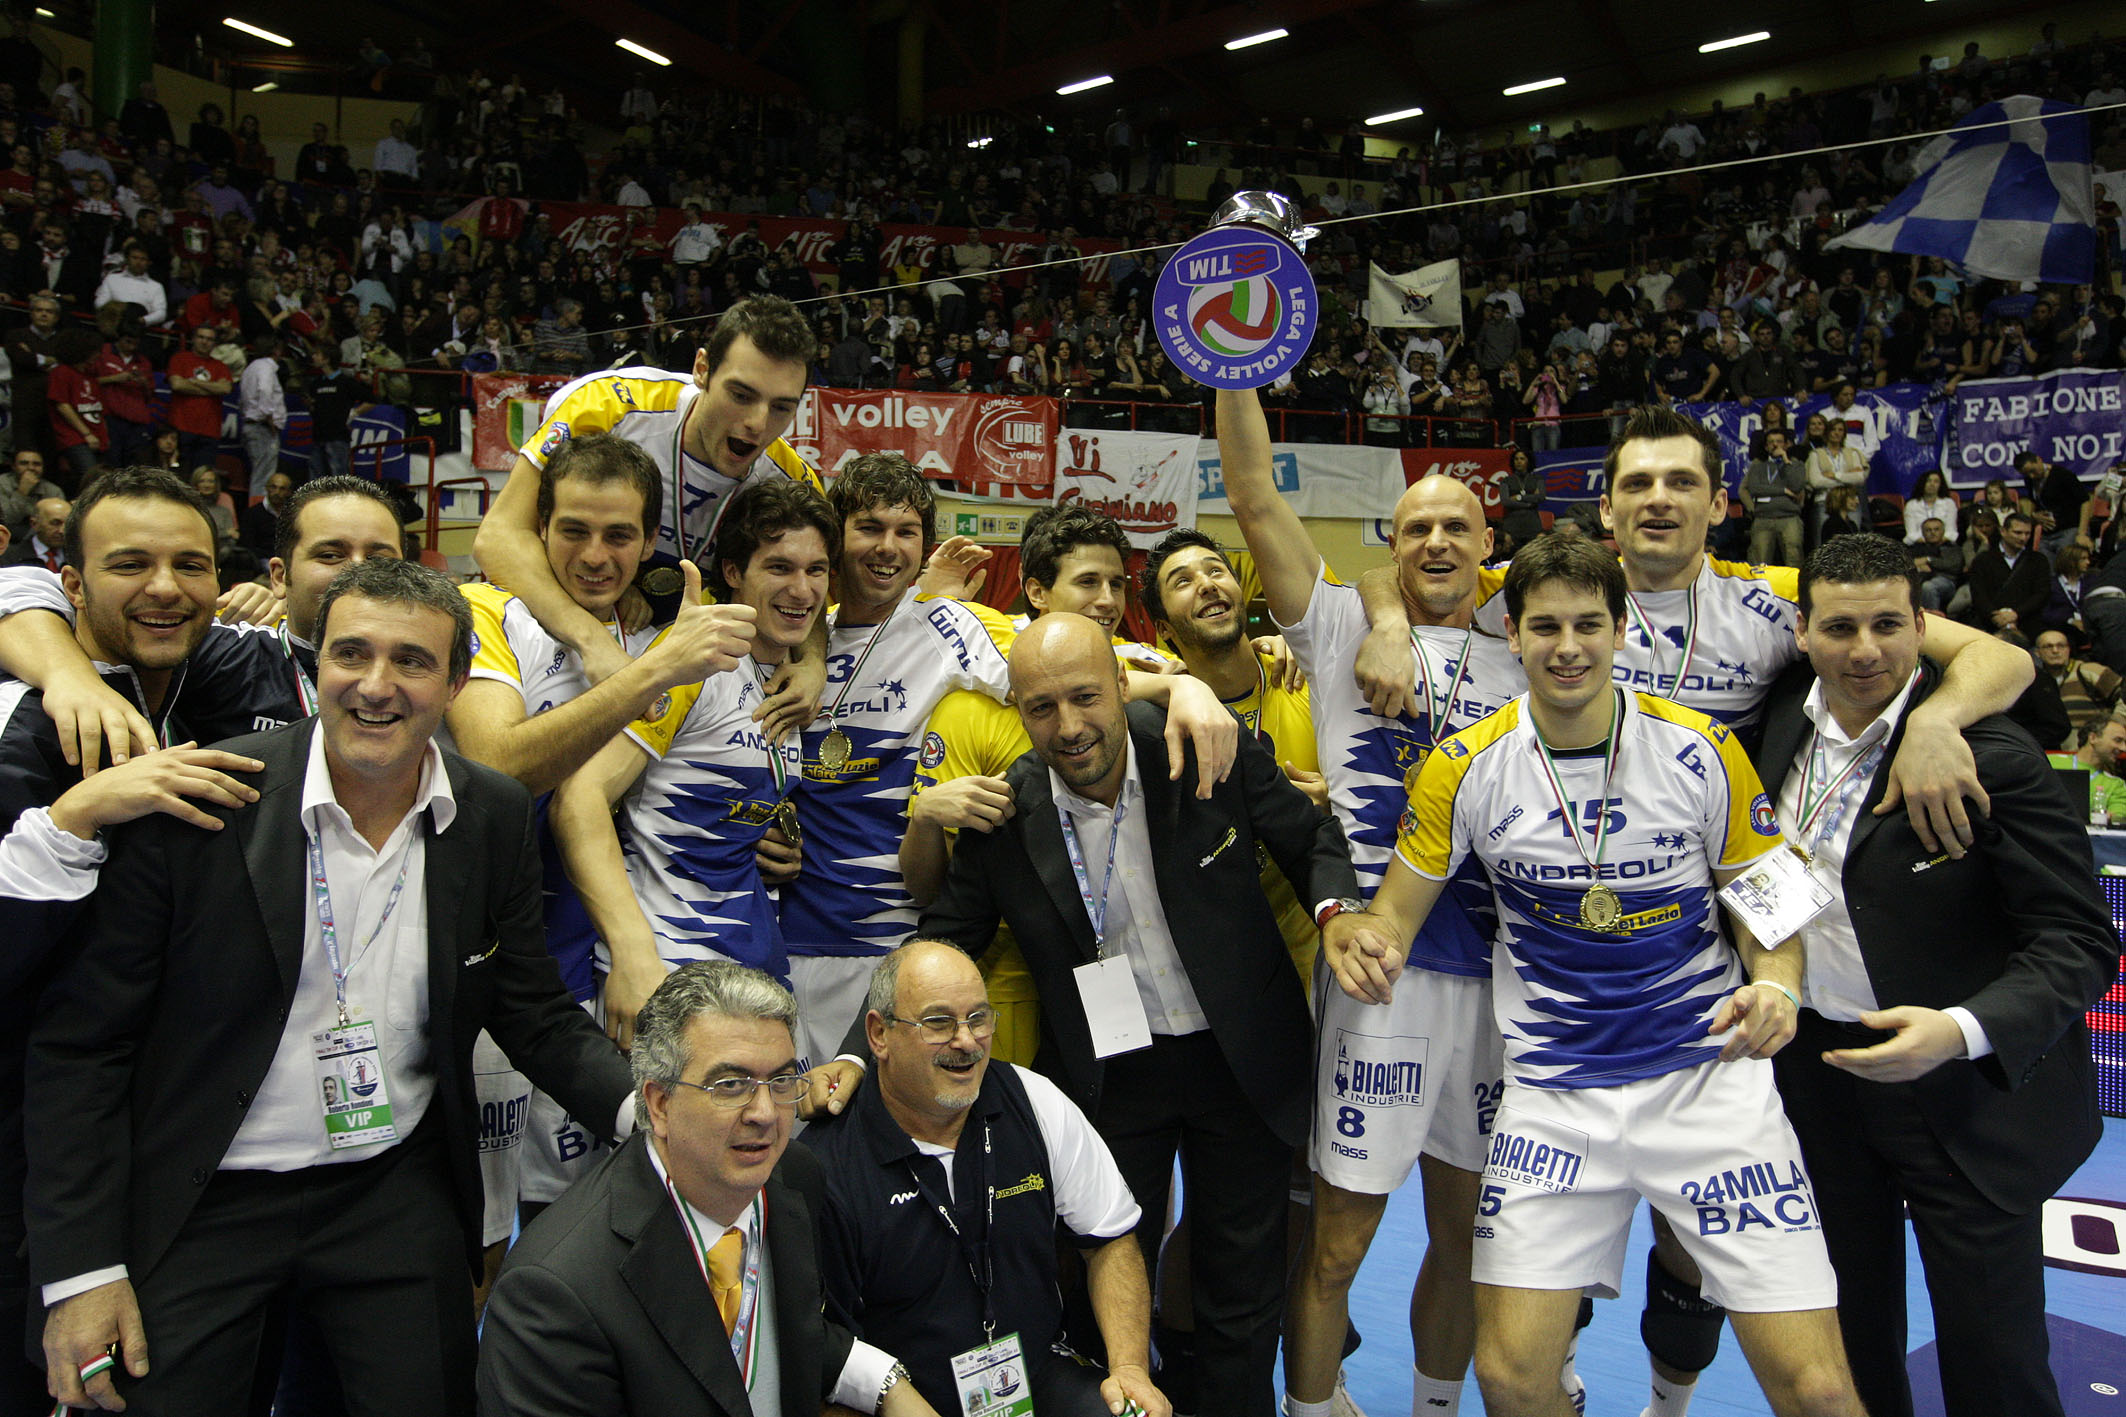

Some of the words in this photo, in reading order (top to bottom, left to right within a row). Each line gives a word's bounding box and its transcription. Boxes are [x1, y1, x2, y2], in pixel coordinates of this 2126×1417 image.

[1189, 255, 1232, 280] TIM
[1164, 304, 1178, 320] A
[1285, 286, 1306, 340] LEGA
[1167, 325, 1212, 373] SERIE
[1215, 344, 1292, 380] VOLLEY
[832, 397, 955, 436] volley
[980, 397, 1024, 415] sempre
[1963, 386, 2122, 423] FABIONE
[1004, 422, 1043, 444] LUBE
[1008, 449, 1045, 462] volley
[1962, 439, 2030, 468] CON
[2052, 432, 2122, 462] NOI
[927, 604, 980, 672] Girmi
[827, 653, 856, 683] 3
[1612, 665, 1735, 691] DREOLI
[1488, 804, 1525, 842] mass
[1547, 797, 1628, 838] 15
[1497, 855, 1674, 881] ANDREOLI
[1638, 908, 1679, 927] Lazio
[1350, 1091, 1420, 1106] INDUSTRIE
[344, 1110, 373, 1129] VIP
[1336, 1106, 1366, 1138] 8
[1331, 1140, 1369, 1160] mass
[1488, 1167, 1572, 1194] INDUSTRIE
[1681, 1159, 1808, 1207] 24MILA
[1473, 1225, 1495, 1239] ass
